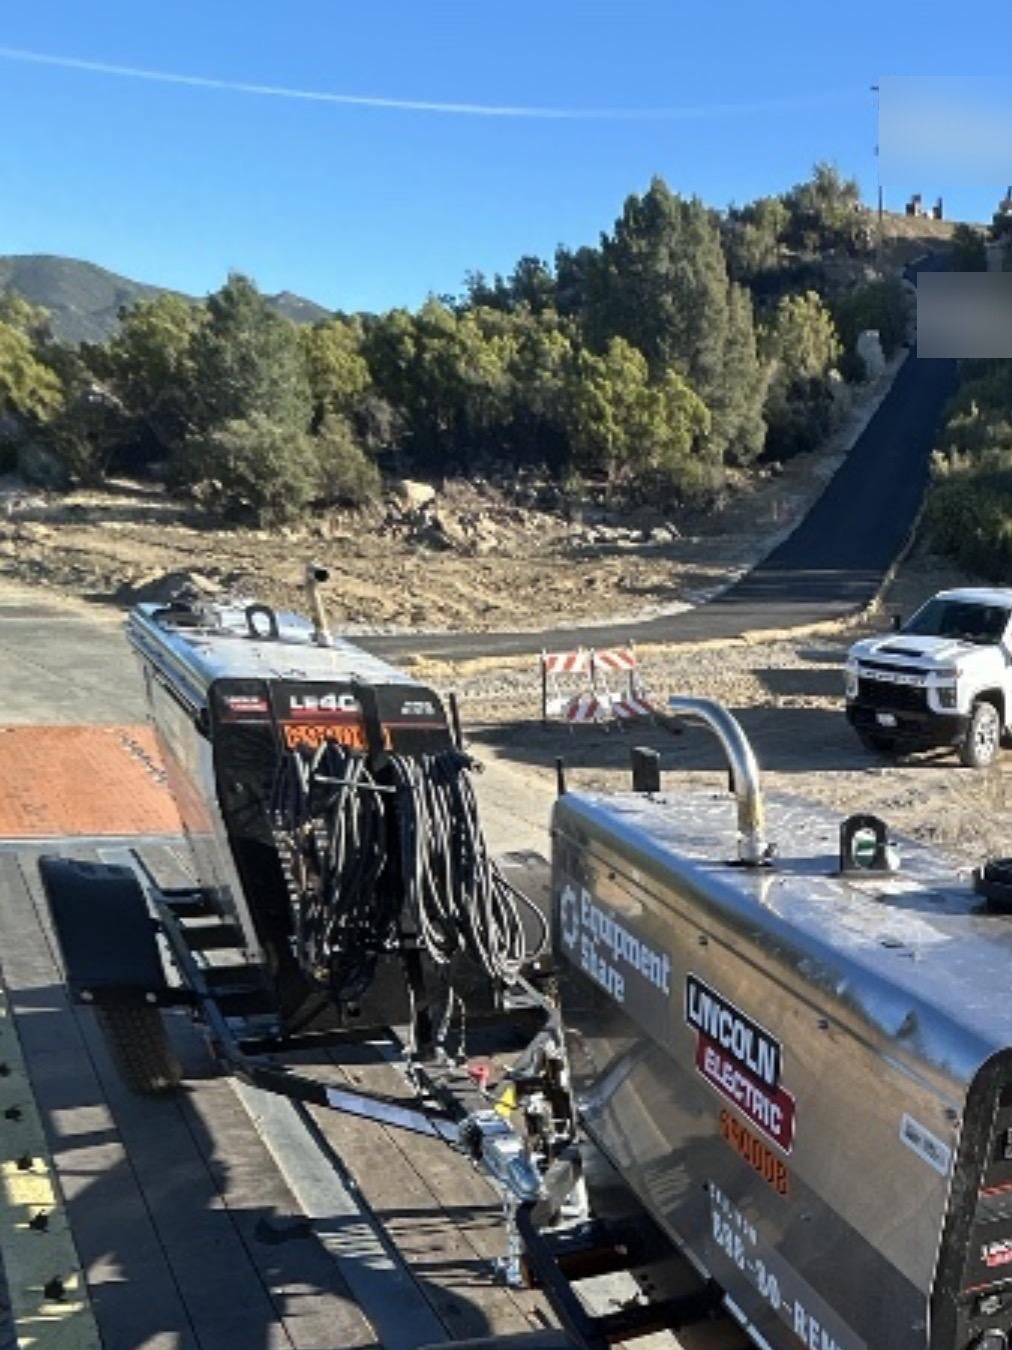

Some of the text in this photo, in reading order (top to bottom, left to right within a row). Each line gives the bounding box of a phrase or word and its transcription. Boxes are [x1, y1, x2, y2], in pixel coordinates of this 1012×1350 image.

[581, 887, 670, 996] Equipment
[581, 932, 625, 1003] Share
[688, 982, 776, 1086] LINCOLN
[703, 1046, 784, 1136] ELECTRIC
